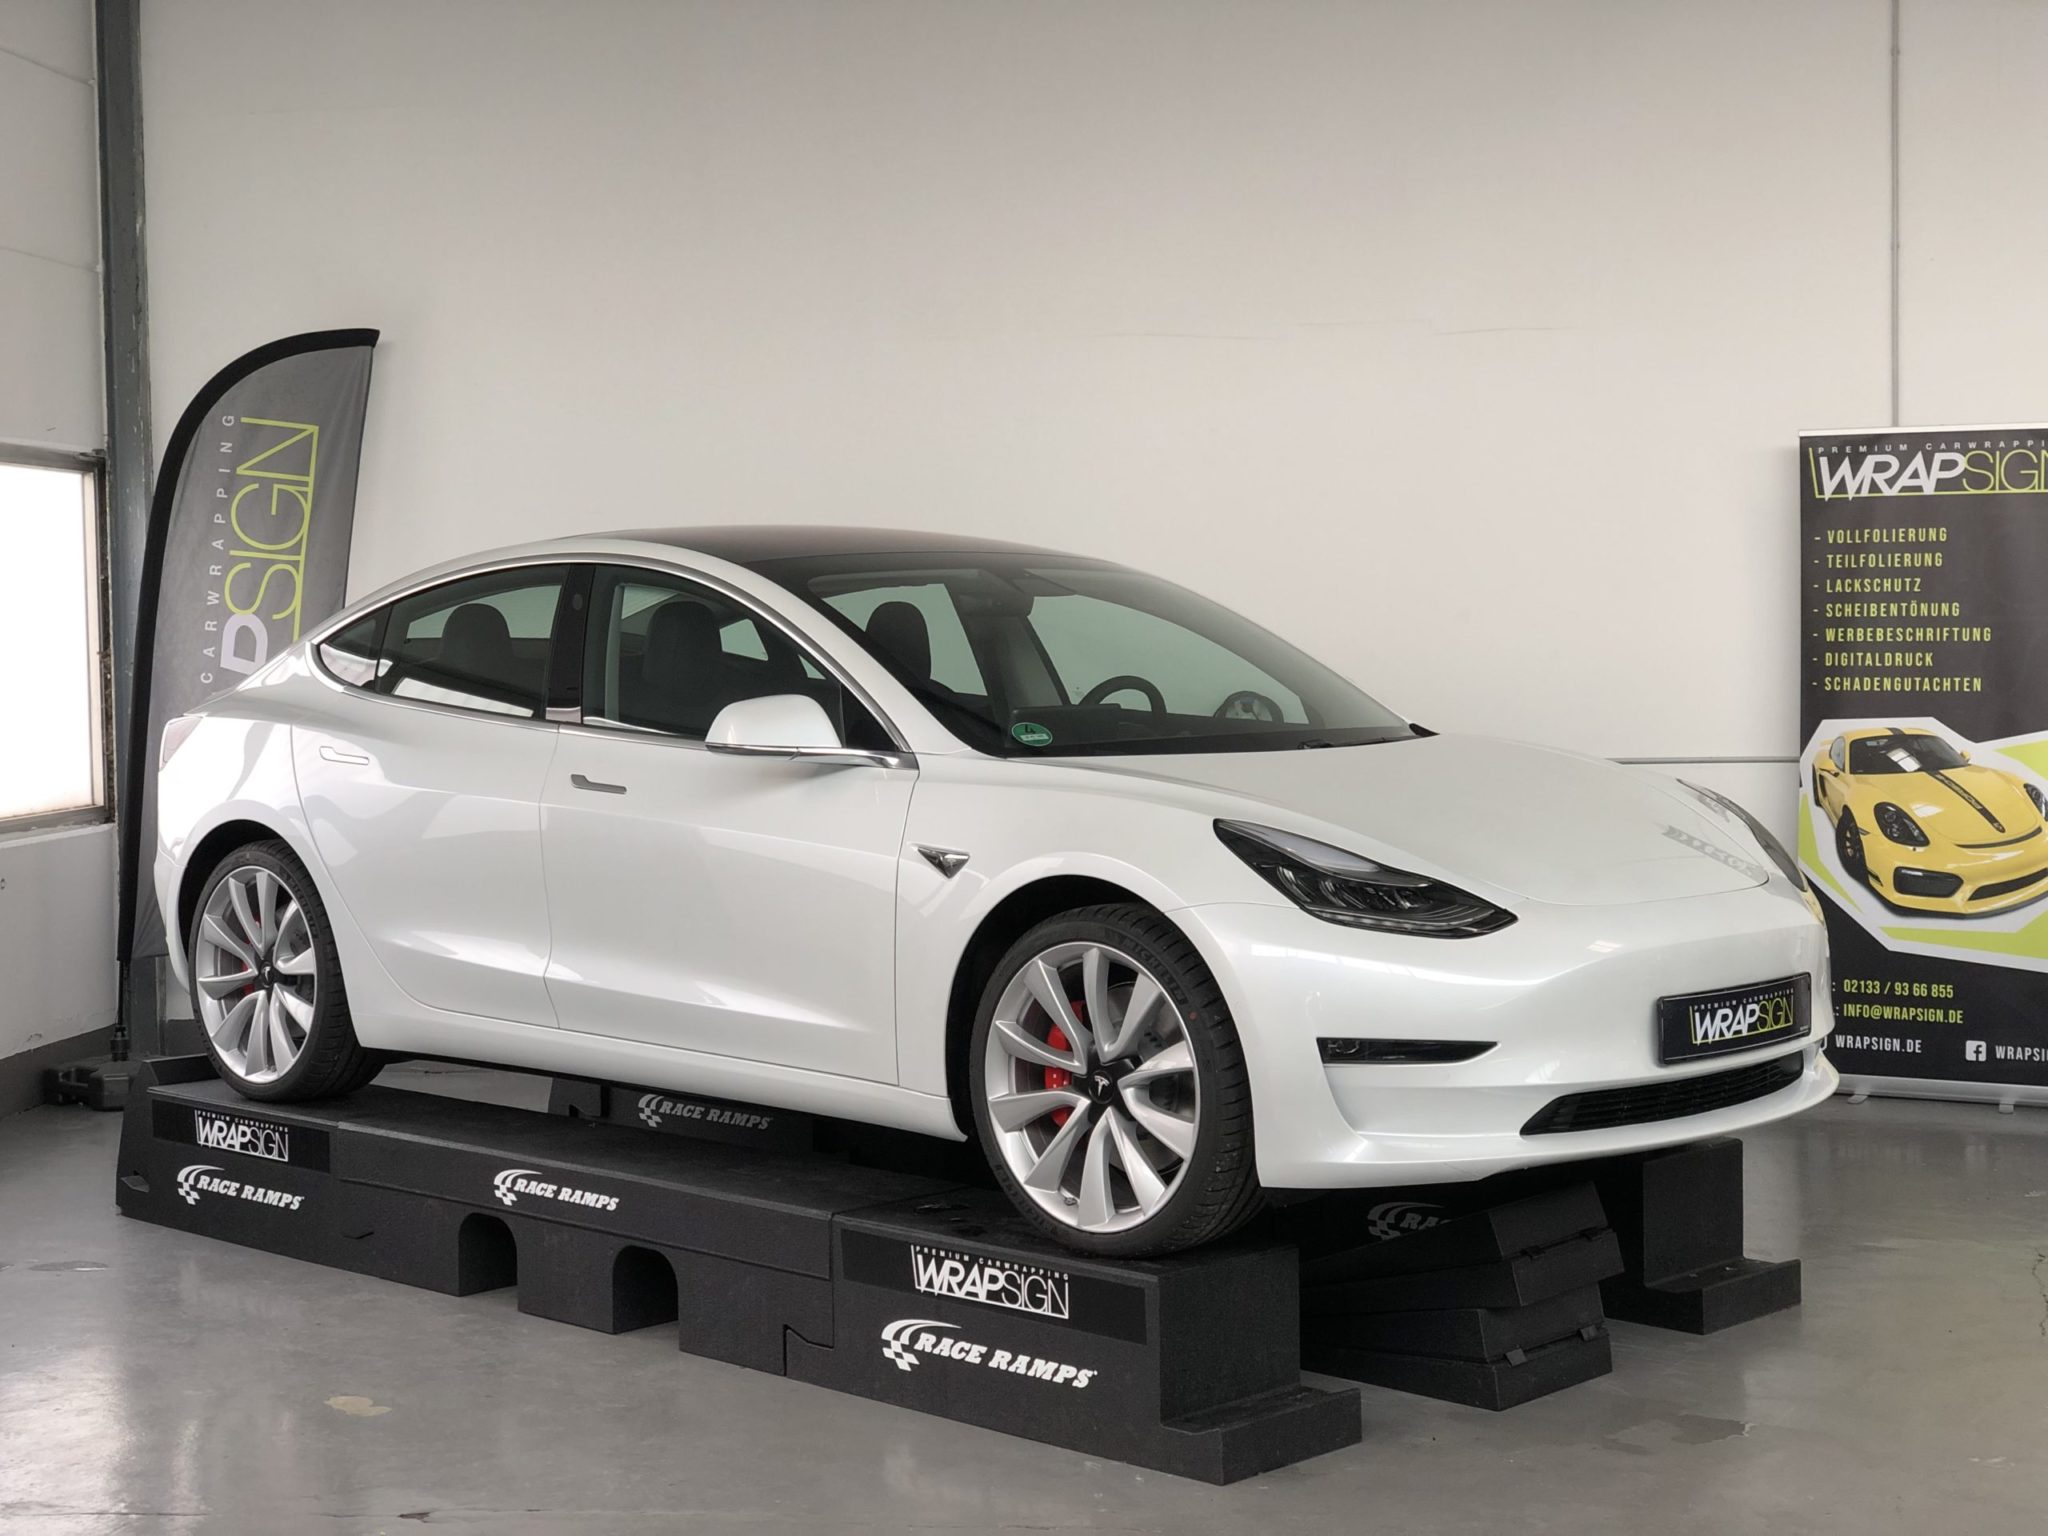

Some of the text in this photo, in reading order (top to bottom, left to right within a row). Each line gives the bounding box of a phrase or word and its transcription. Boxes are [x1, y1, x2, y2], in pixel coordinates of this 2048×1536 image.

[1818, 439, 2046, 455] PREMIUM CARWRAPPI
[1827, 527, 1948, 544] VOLLFOLIERUNG
[200, 414, 235, 685] CARWRAPPING
[1826, 552, 1943, 568] TEILFOLIERUNG
[1826, 577, 1922, 593] LACKSCHUTZ
[1825, 600, 1960, 617] SCHEIBENTÖNUNG
[1825, 627, 1992, 642] WERBEBESCHRIFTUNG
[1825, 652, 1934, 667] DIGITALDRUCK
[1824, 677, 1982, 692] SCHADENGUTACHTEN
[1843, 979, 1881, 994] 02133
[1894, 982, 1909, 996] 93
[1912, 983, 1928, 997] 66
[1931, 984, 1954, 998] 855
[1694, 995, 1794, 1046] WRAPSIGN
[1843, 1003, 1964, 1024] INFO@WRAPSIGN.DE
[1835, 1034, 1922, 1053] WRAPSIGN.DE
[1995, 1045, 2048, 1062] WRAPSI
[659, 1100, 771, 1130] RACE RAMPS
[198, 1116, 289, 1162] WRAPSIGN
[196, 1174, 302, 1211] RACE RAMPS
[513, 1177, 620, 1212] RACE RAMPS
[916, 1245, 1070, 1281] PREMIUM CARWRAPPING
[916, 1253, 1069, 1320] WRAPSIGN
[913, 1332, 1093, 1389] RACE RAMPS
